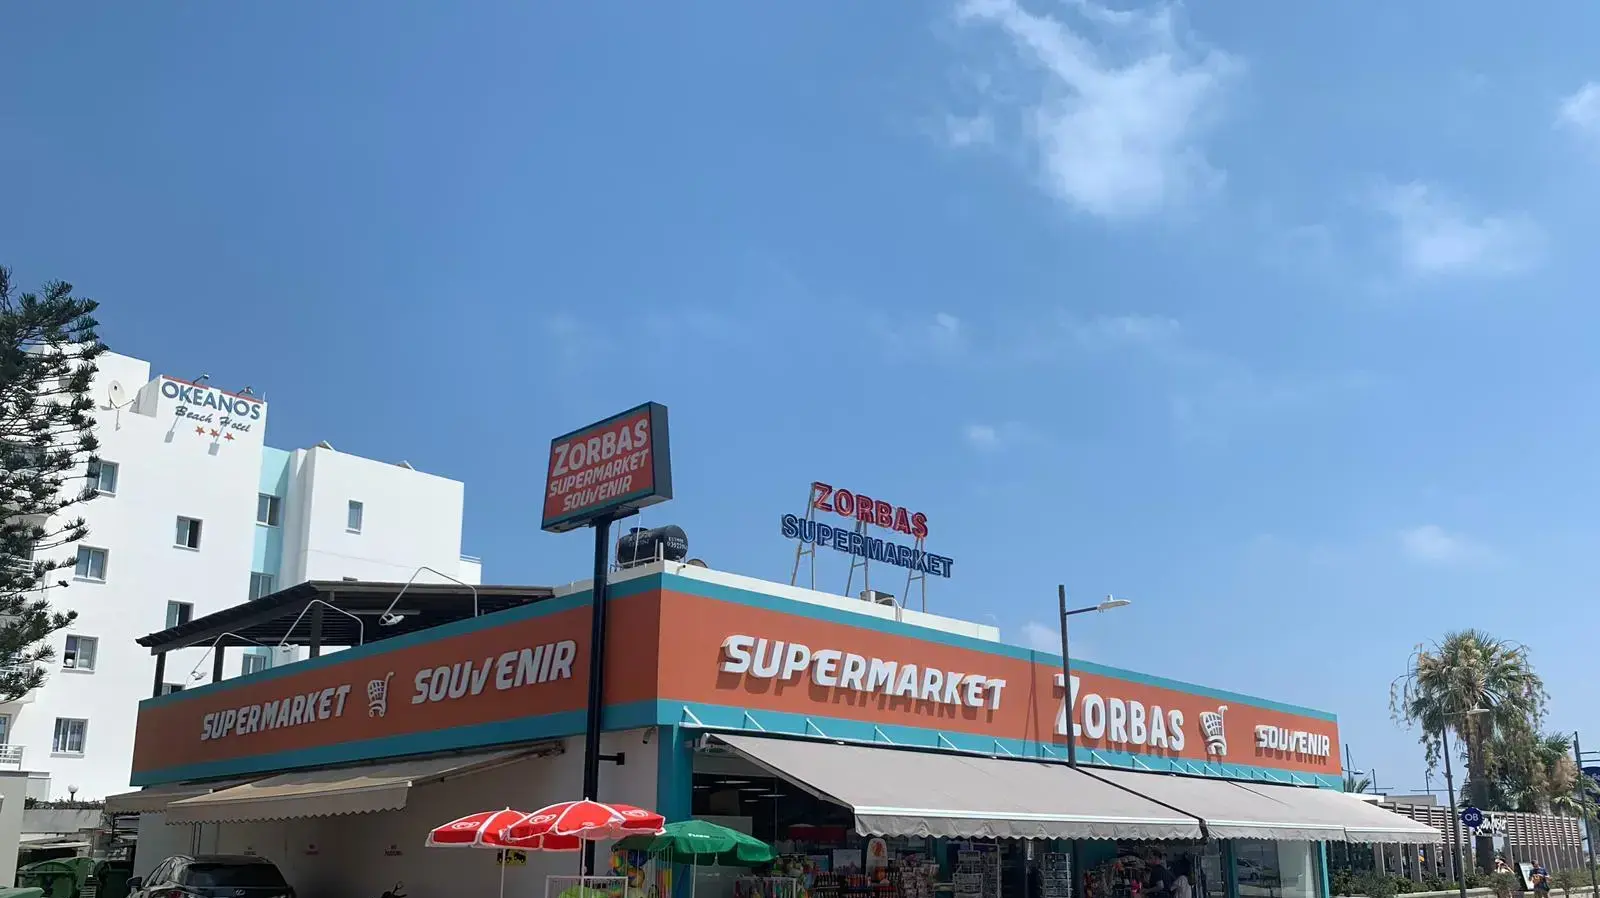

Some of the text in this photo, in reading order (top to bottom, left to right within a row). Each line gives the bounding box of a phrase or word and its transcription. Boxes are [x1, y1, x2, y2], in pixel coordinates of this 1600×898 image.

[161, 381, 261, 420] OKEANOS
[175, 406, 252, 432] Beach Hotel
[548, 449, 649, 498] SUPERMARKET
[552, 419, 648, 477] ZORBAS
[562, 475, 632, 511] SOUVENIR
[812, 481, 928, 538] ZORBAS
[782, 513, 953, 578] SUPERMARKET
[201, 640, 577, 741] SUPERMARKET SOUVENIR
[720, 634, 1330, 757] SUPERMARKET ZORBAS SOUVENIR
[1464, 813, 1479, 822] OB
